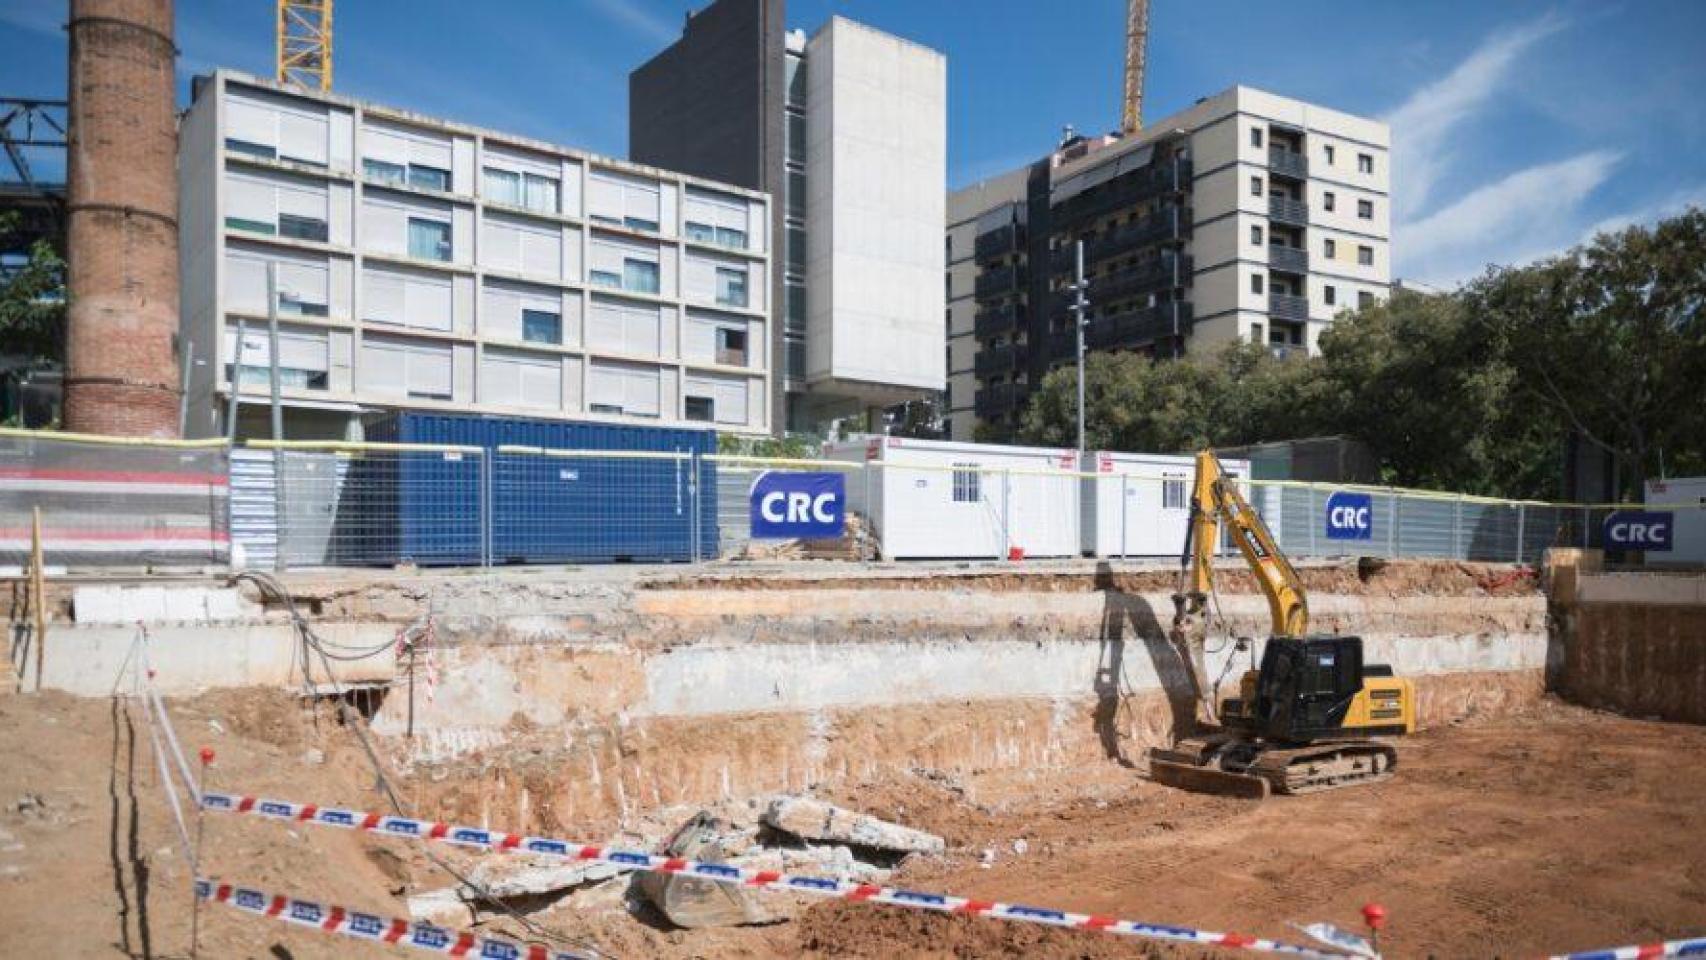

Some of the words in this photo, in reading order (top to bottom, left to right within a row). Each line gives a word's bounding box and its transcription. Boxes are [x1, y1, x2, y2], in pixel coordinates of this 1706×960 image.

[762, 491, 836, 523] CRC
[1332, 506, 1368, 529] CRC
[1612, 523, 1665, 542] CRC
